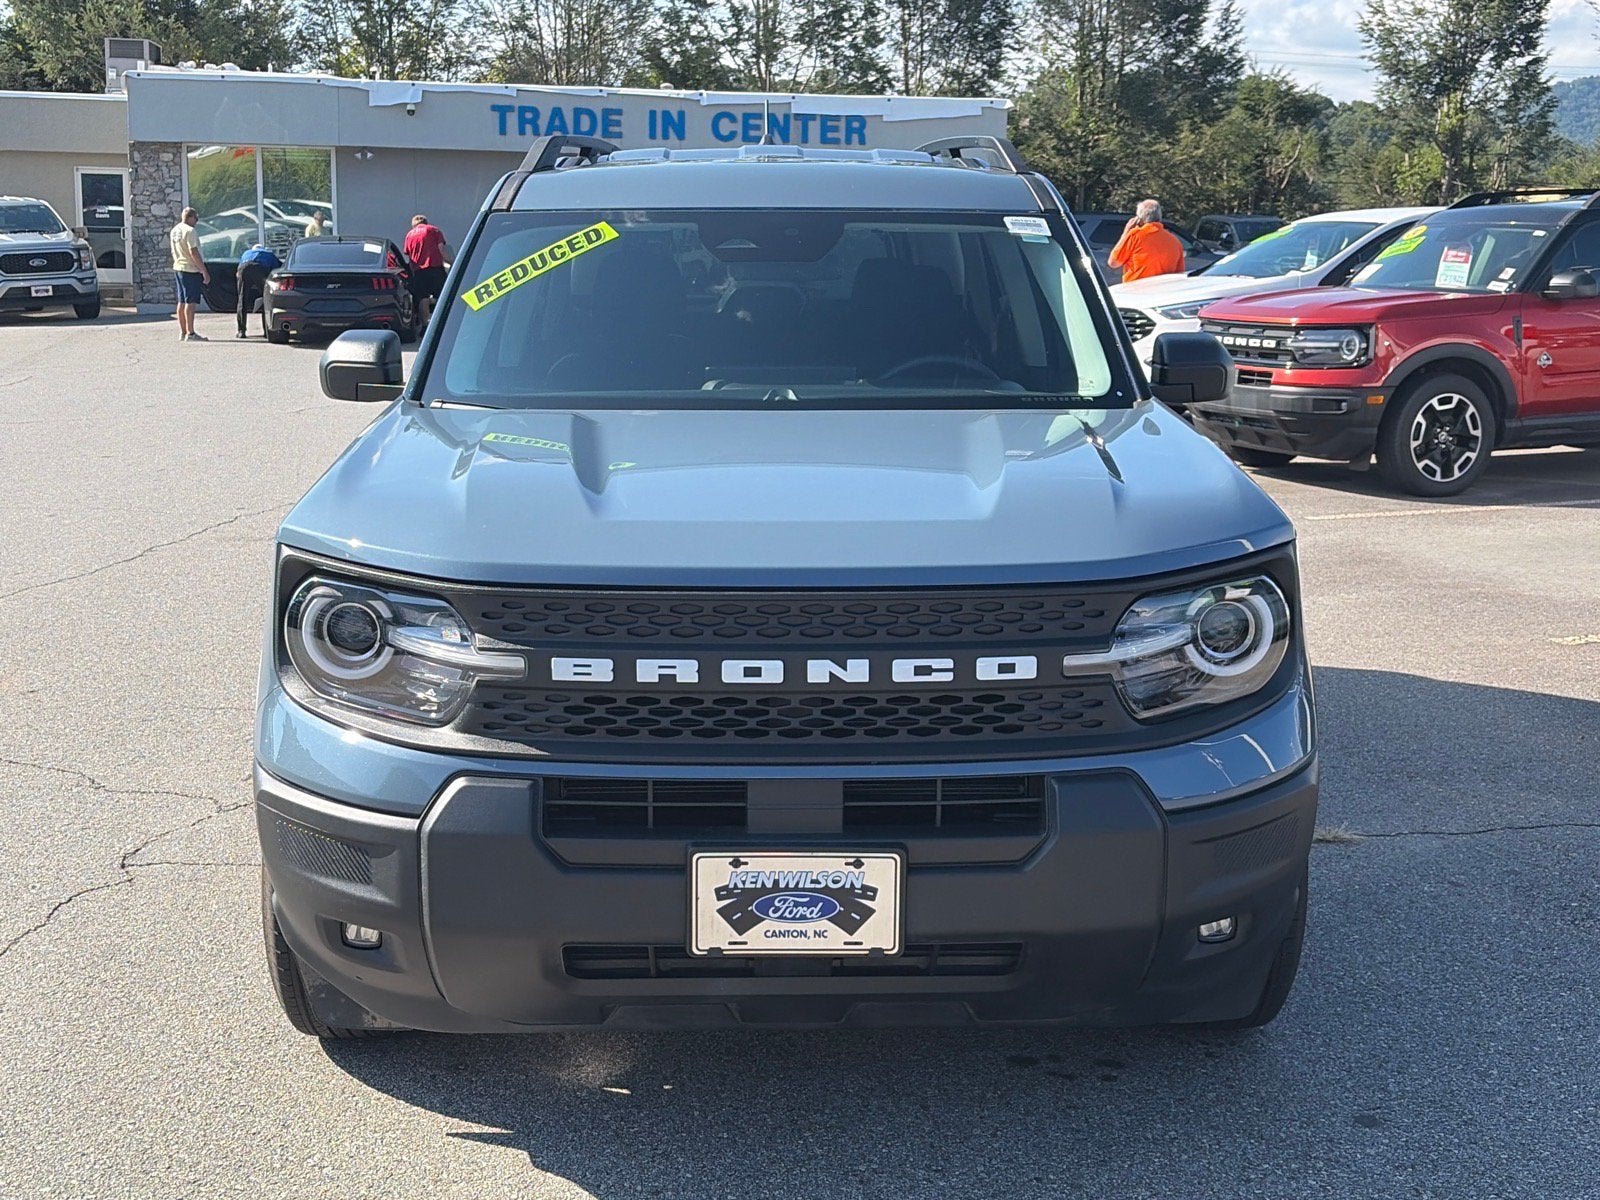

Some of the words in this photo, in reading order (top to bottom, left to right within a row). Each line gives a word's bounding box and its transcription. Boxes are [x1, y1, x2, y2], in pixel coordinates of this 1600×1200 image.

[490, 104, 624, 139] TRADE
[648, 109, 687, 141] IN
[711, 111, 867, 146] CENTER
[473, 228, 606, 304] REDUCED
[551, 656, 1038, 684] BRONCO
[728, 870, 775, 888] KEN
[777, 871, 865, 889] WILSON
[768, 895, 823, 919] Ford
[763, 929, 811, 940] CANTON,
[813, 929, 828, 939] NC
